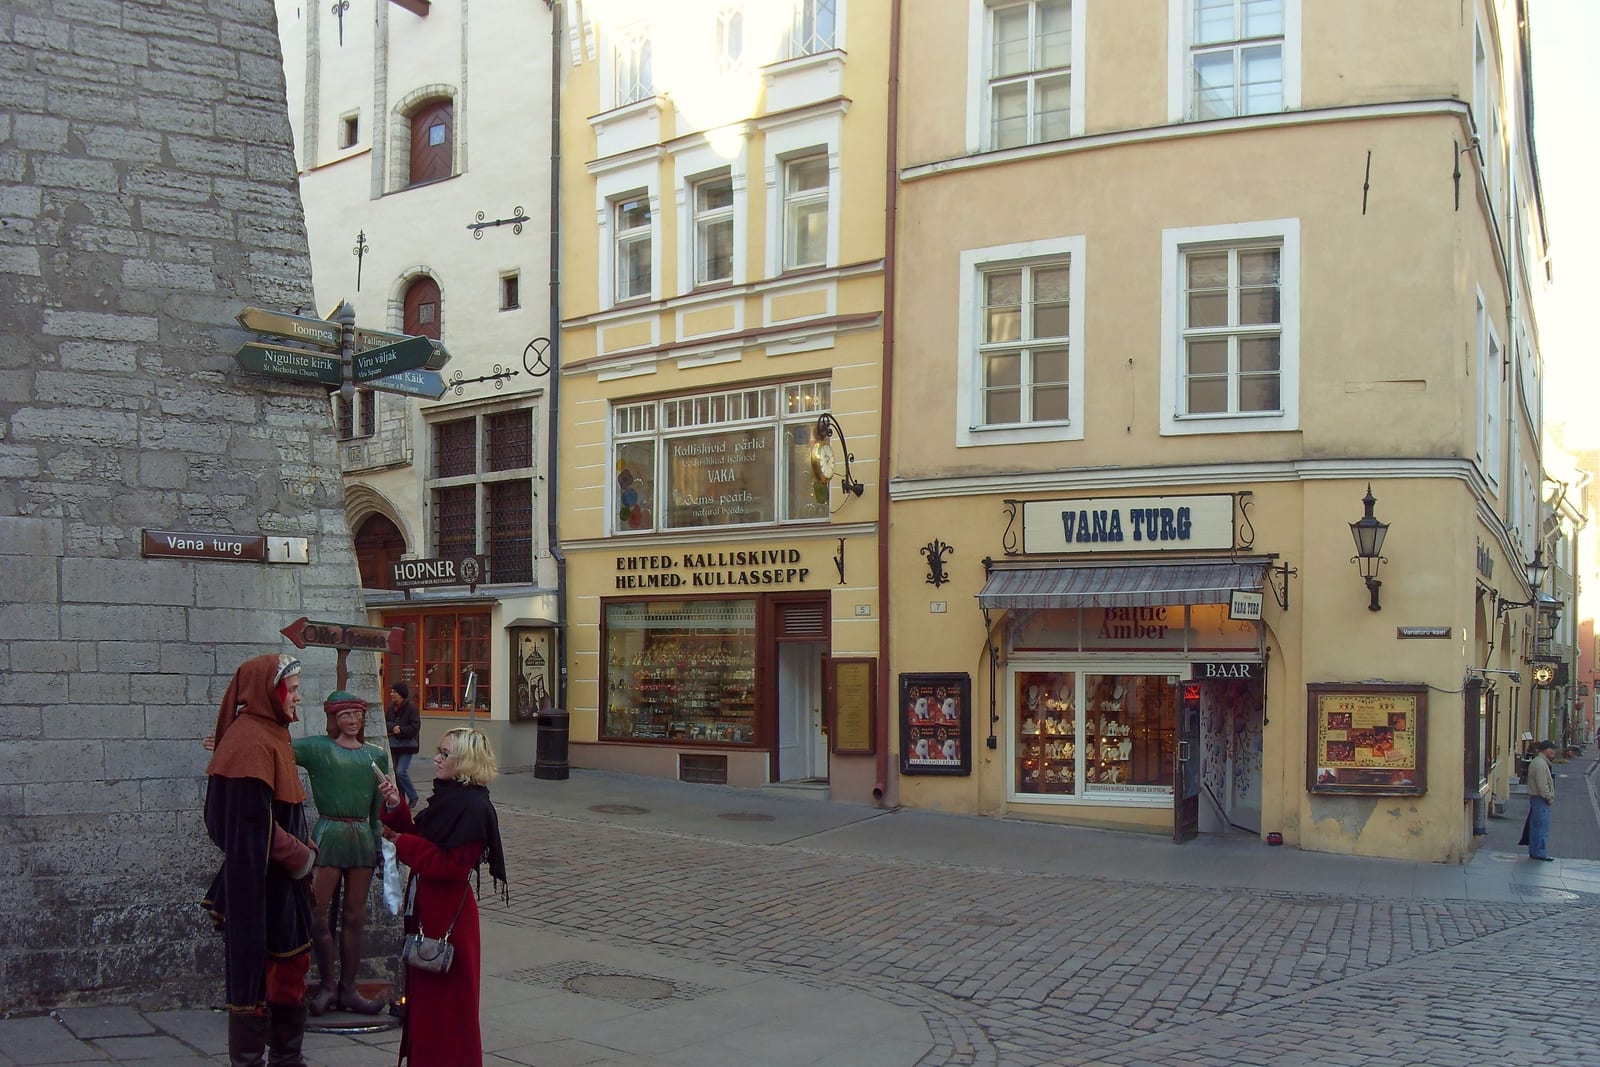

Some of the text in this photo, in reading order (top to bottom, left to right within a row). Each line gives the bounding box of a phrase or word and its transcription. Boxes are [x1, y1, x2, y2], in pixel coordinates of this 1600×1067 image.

[291, 321, 333, 340] Toompea
[264, 350, 333, 370] Niguliste kirik
[358, 349, 397, 368] Viru väljak
[272, 365, 298, 375] Nicholas
[299, 368, 319, 376] Church
[674, 437, 765, 457] Kalliskivid pärlid
[707, 468, 736, 483] VAKA
[720, 490, 753, 505] pearls
[1061, 506, 1192, 543] VANA TURG
[166, 536, 242, 555] Vana turg
[282, 541, 290, 558] 1
[683, 549, 801, 568] KALLISKIVID
[394, 560, 456, 580] HOPNER
[692, 568, 810, 586] KULLASSEPP
[860, 606, 865, 614] 5
[935, 603, 941, 611] 7
[1103, 606, 1167, 622] Baltic
[1098, 620, 1168, 639] Amber
[1206, 663, 1251, 678] BAAR
